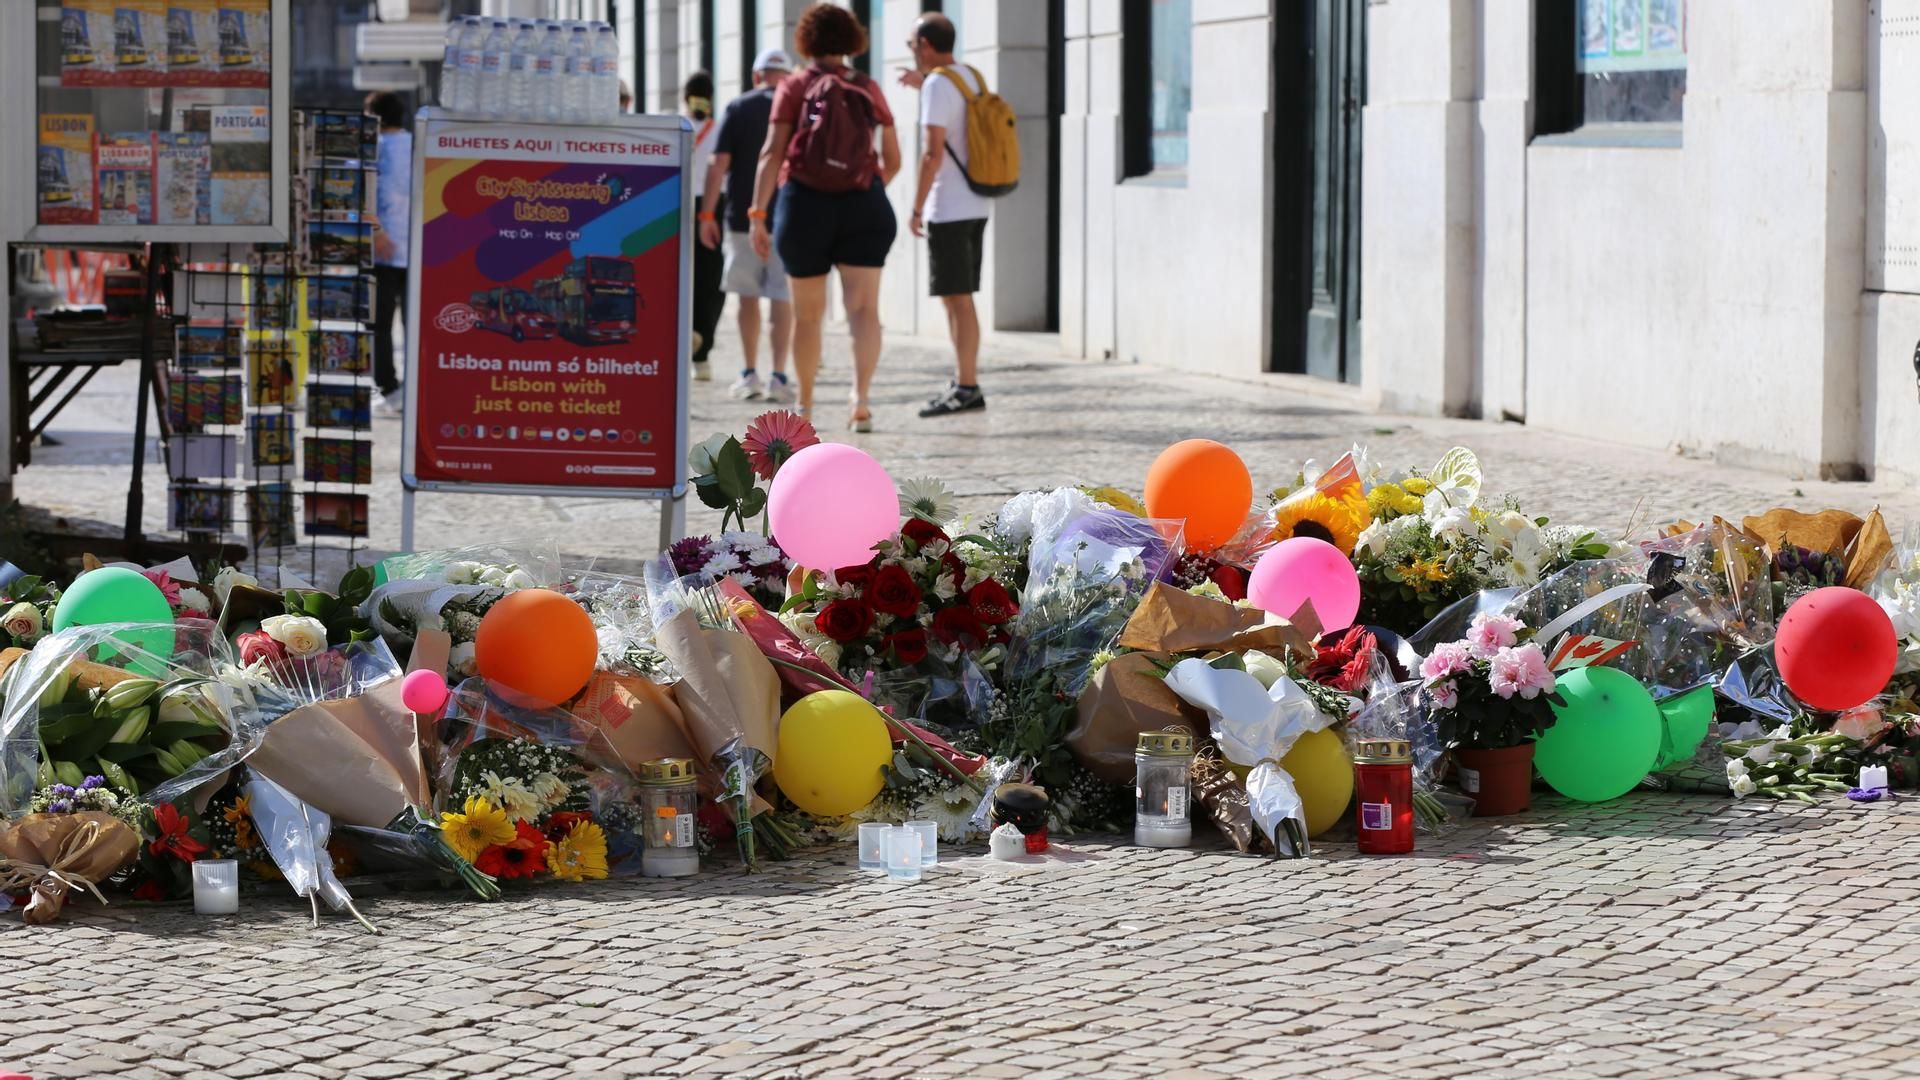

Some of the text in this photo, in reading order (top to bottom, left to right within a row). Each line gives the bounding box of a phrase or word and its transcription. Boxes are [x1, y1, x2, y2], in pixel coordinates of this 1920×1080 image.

[45, 118, 87, 132] LISBON
[214, 115, 268, 128] PORTUGAL
[438, 136, 671, 156] BILHETES AQUI TICKETS HERE
[514, 202, 569, 222] Lisboa
[499, 228, 518, 240] Hop
[520, 229, 534, 239] On
[545, 230, 564, 241] Hop
[438, 353, 659, 376] Lisboa num só bilhete!
[491, 375, 607, 395] Lisbon with
[473, 395, 622, 415] just one ticket!
